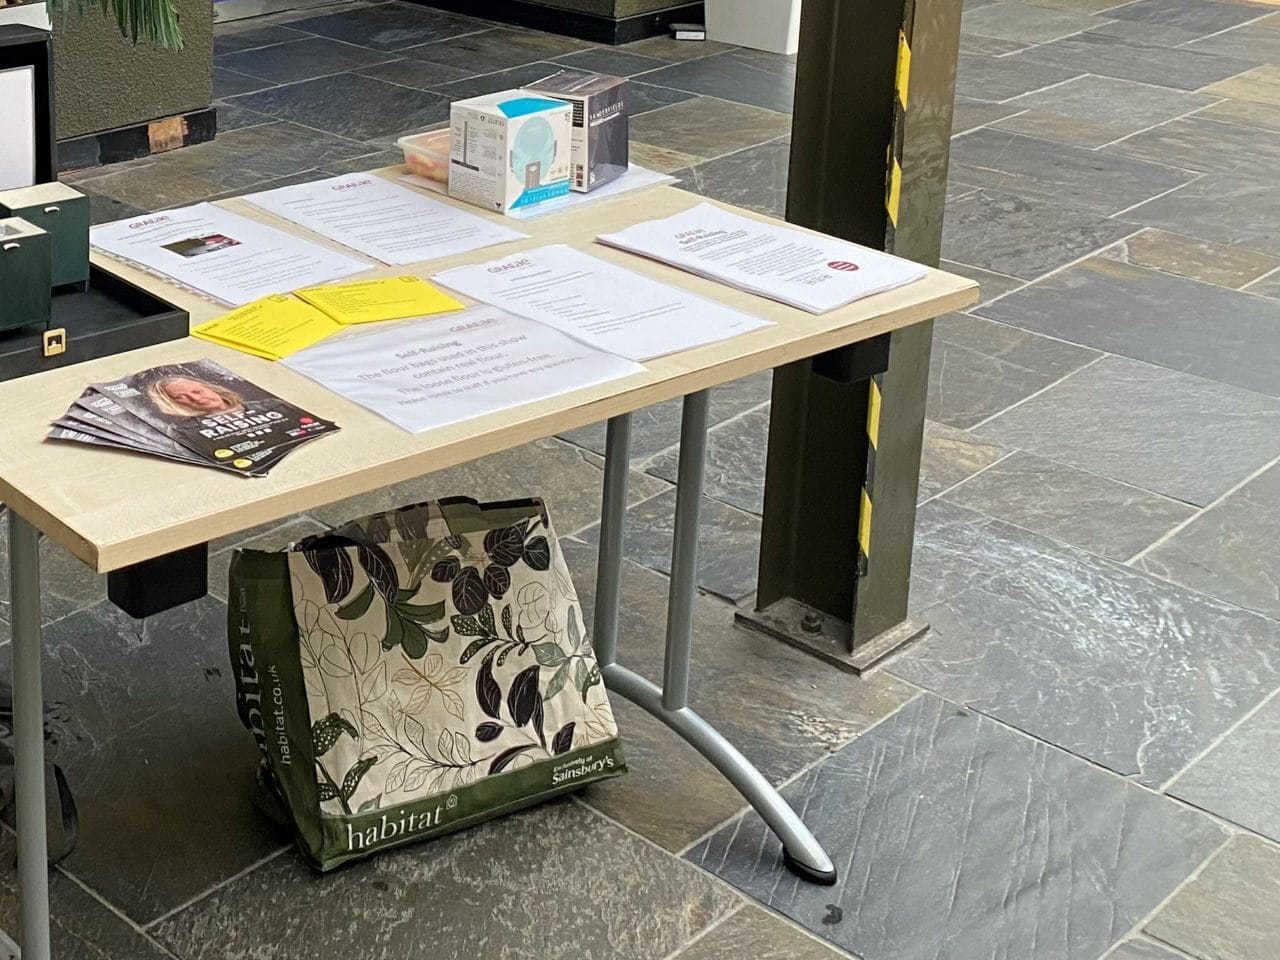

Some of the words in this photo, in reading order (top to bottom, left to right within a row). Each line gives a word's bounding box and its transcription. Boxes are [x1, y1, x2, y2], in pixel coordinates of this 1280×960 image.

[357, 371, 383, 381] The
[381, 364, 410, 376] flour
[408, 358, 439, 369] bags
[498, 334, 528, 346] show
[199, 411, 283, 438] RAISING
[268, 664, 291, 765] habitat.co.uk
[551, 754, 614, 785] Sainsbury's
[345, 803, 446, 851] habitat
